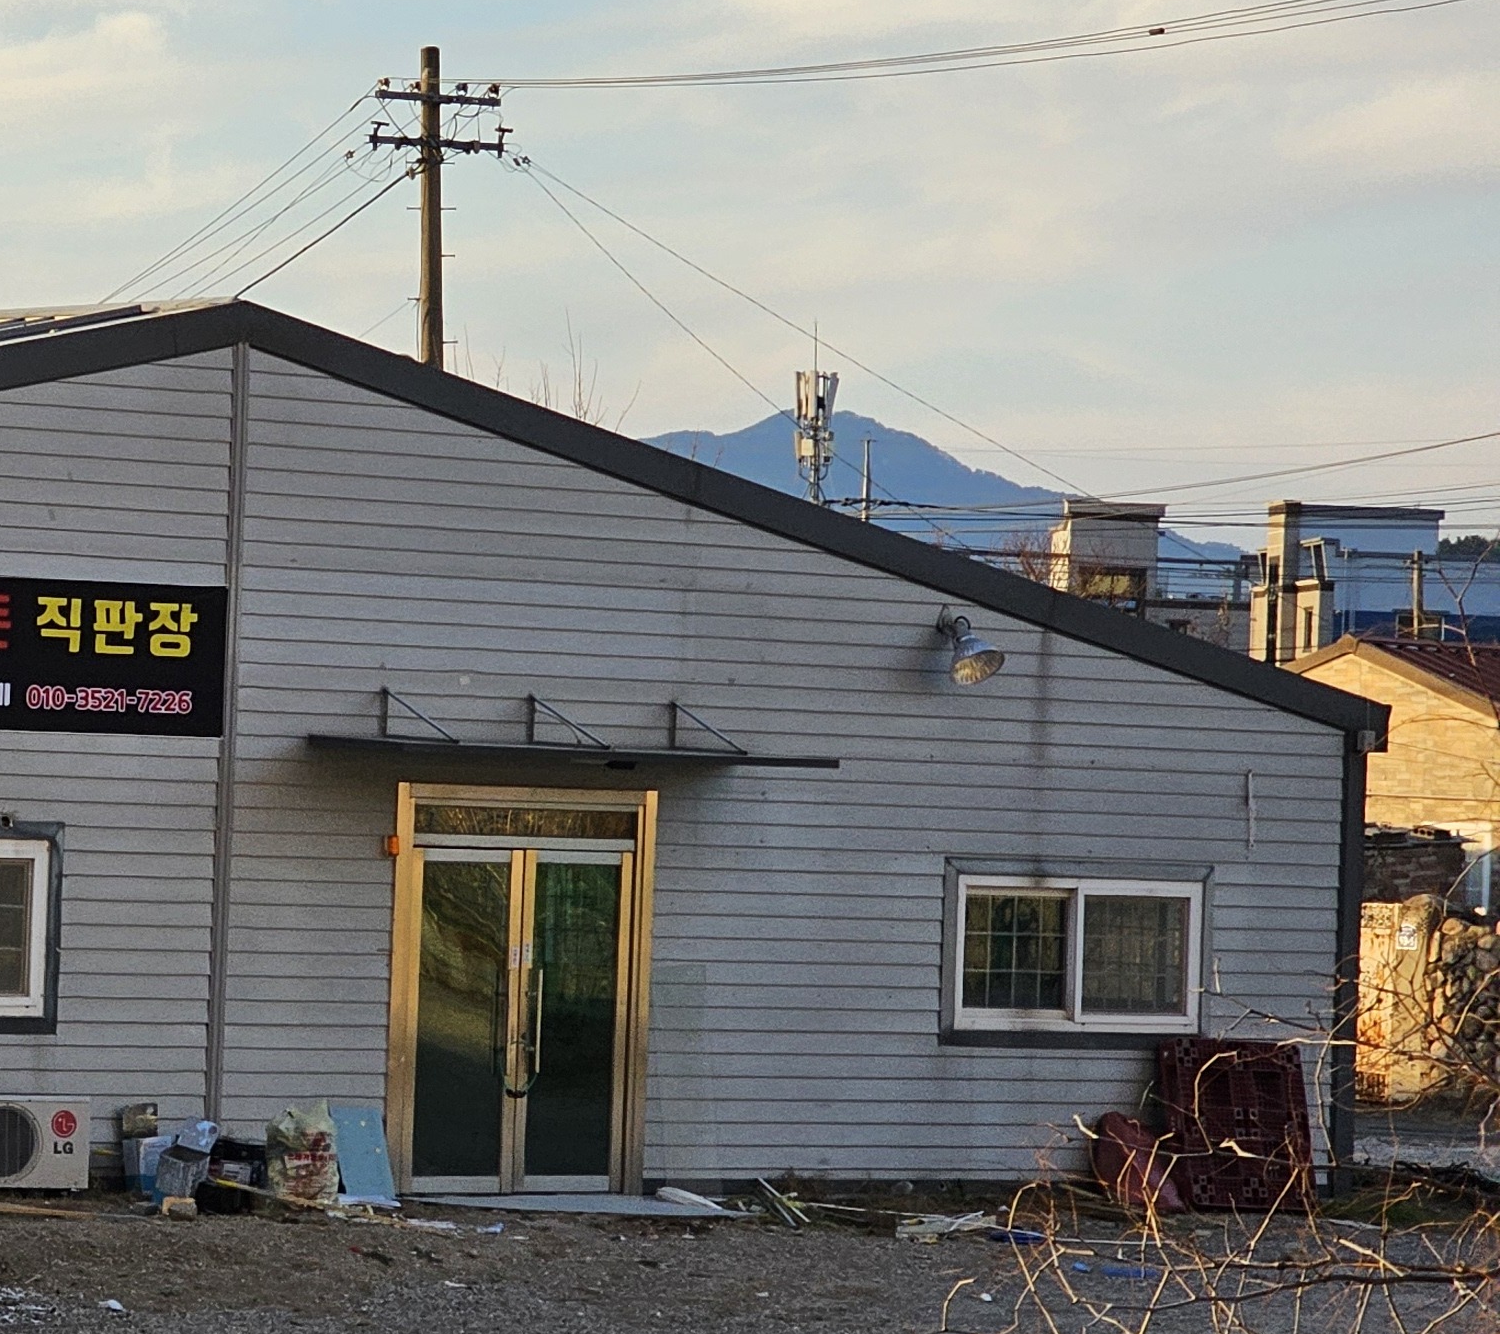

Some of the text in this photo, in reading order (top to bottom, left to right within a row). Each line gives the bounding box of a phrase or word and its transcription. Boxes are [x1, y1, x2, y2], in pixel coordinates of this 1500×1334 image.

[36, 595, 198, 658] 직판장
[26, 684, 193, 714] 010-3521-7226
[53, 1141, 74, 1155] LG
